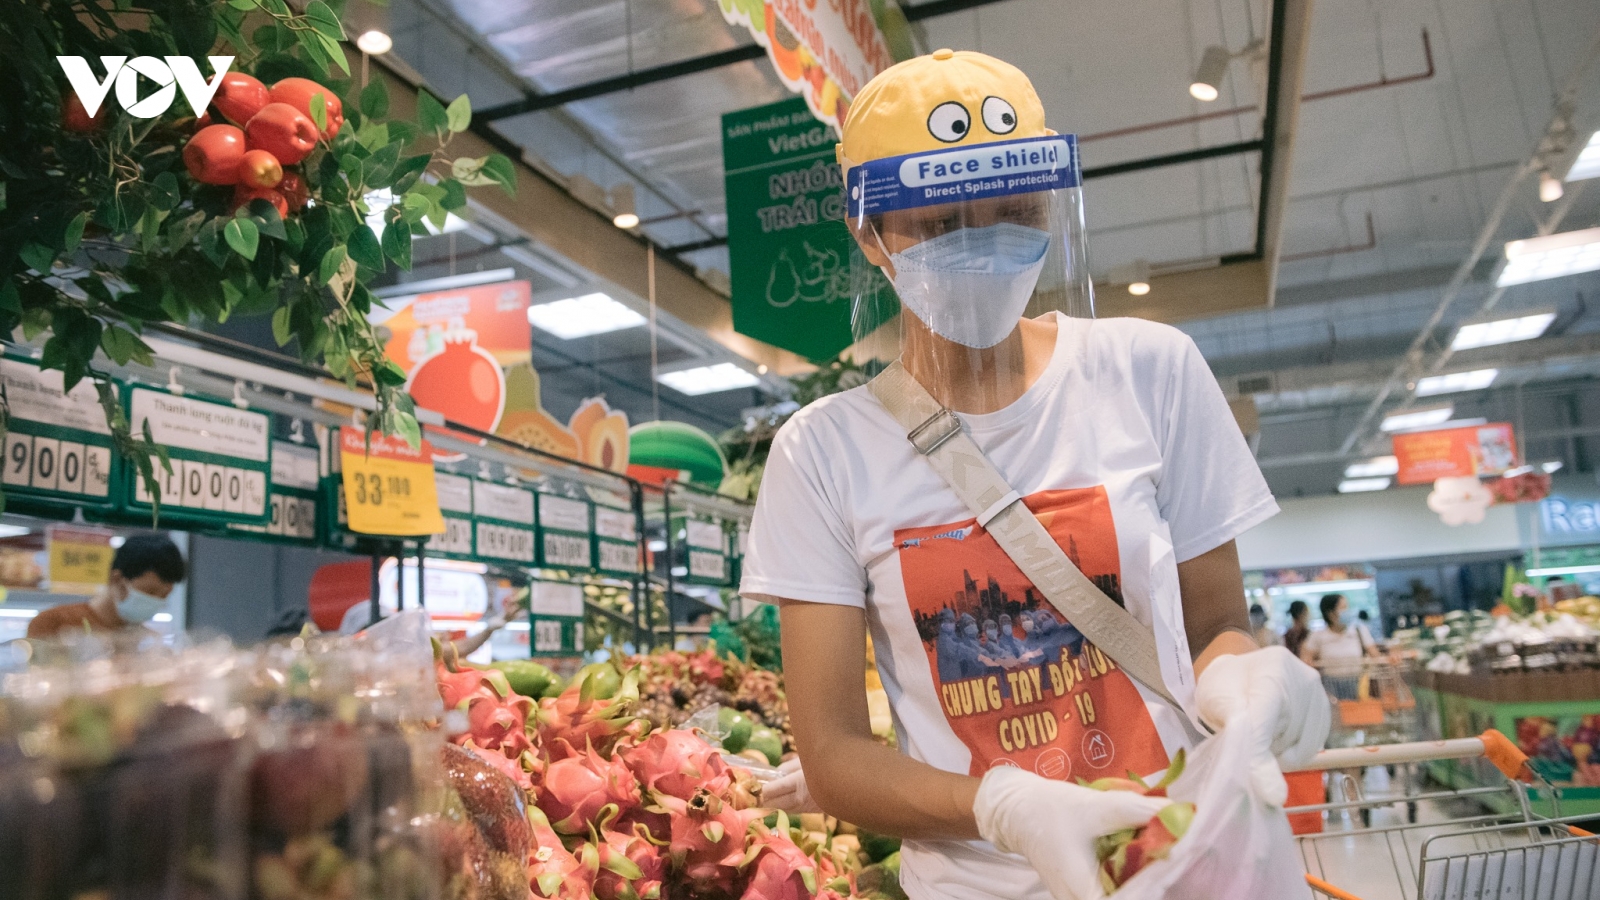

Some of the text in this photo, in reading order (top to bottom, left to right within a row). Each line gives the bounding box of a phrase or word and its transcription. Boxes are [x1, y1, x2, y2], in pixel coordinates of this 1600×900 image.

[768, 125, 839, 154] VietGA
[769, 159, 843, 199] NHÓN
[918, 160, 979, 180] Face
[991, 146, 1058, 169] shield
[925, 172, 1058, 198] Direct Splash protection
[154, 398, 186, 416] Thanh
[1542, 496, 1600, 532] Ra
[941, 676, 1003, 717] CHUNG
[1007, 666, 1044, 706] TAY
[998, 709, 1059, 752] COVID
[1075, 692, 1096, 725] 19
